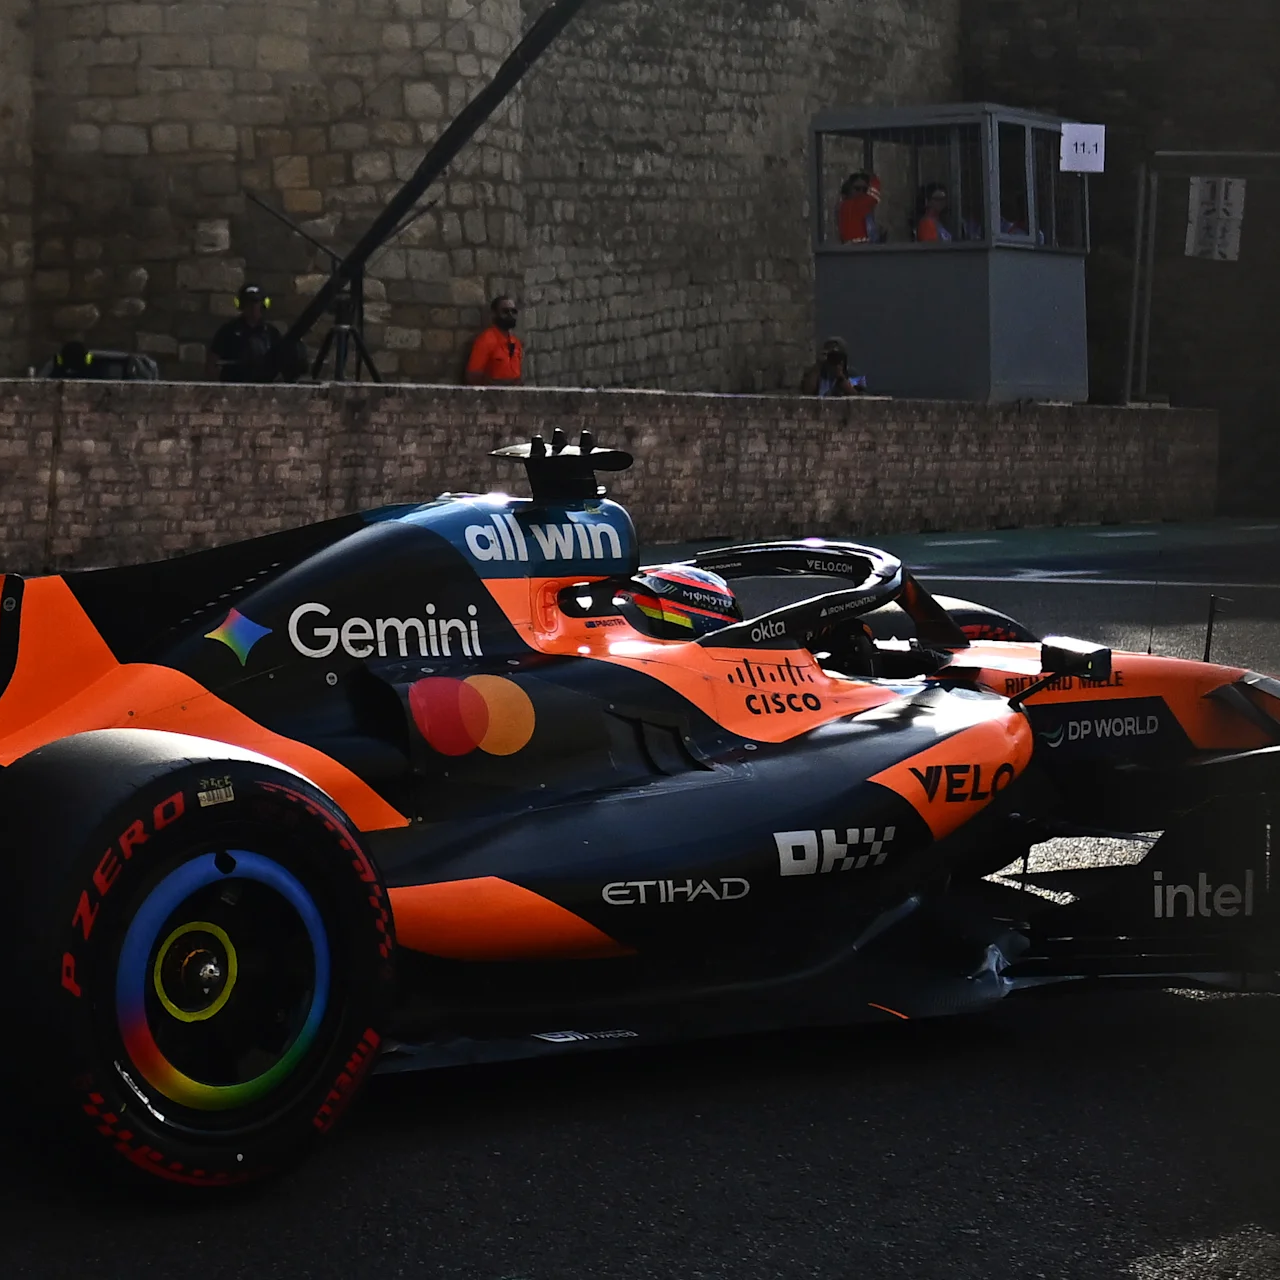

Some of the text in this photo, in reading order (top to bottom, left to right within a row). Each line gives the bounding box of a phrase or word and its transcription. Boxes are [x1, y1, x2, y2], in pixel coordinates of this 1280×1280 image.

[1073, 141, 1098, 154] 11.1
[465, 510, 622, 561] all win
[806, 559, 853, 573] VELO.COM
[828, 595, 877, 615] IRON MOUNTAIN
[288, 602, 483, 658] Gemini
[751, 619, 786, 642] okta
[745, 693, 821, 715] CISCO
[1068, 715, 1159, 741] DP WORLD
[909, 762, 1014, 803] VELO
[60, 790, 186, 998] P ZERO
[601, 877, 751, 906] ETIHAD
[1153, 869, 1254, 918] intel
